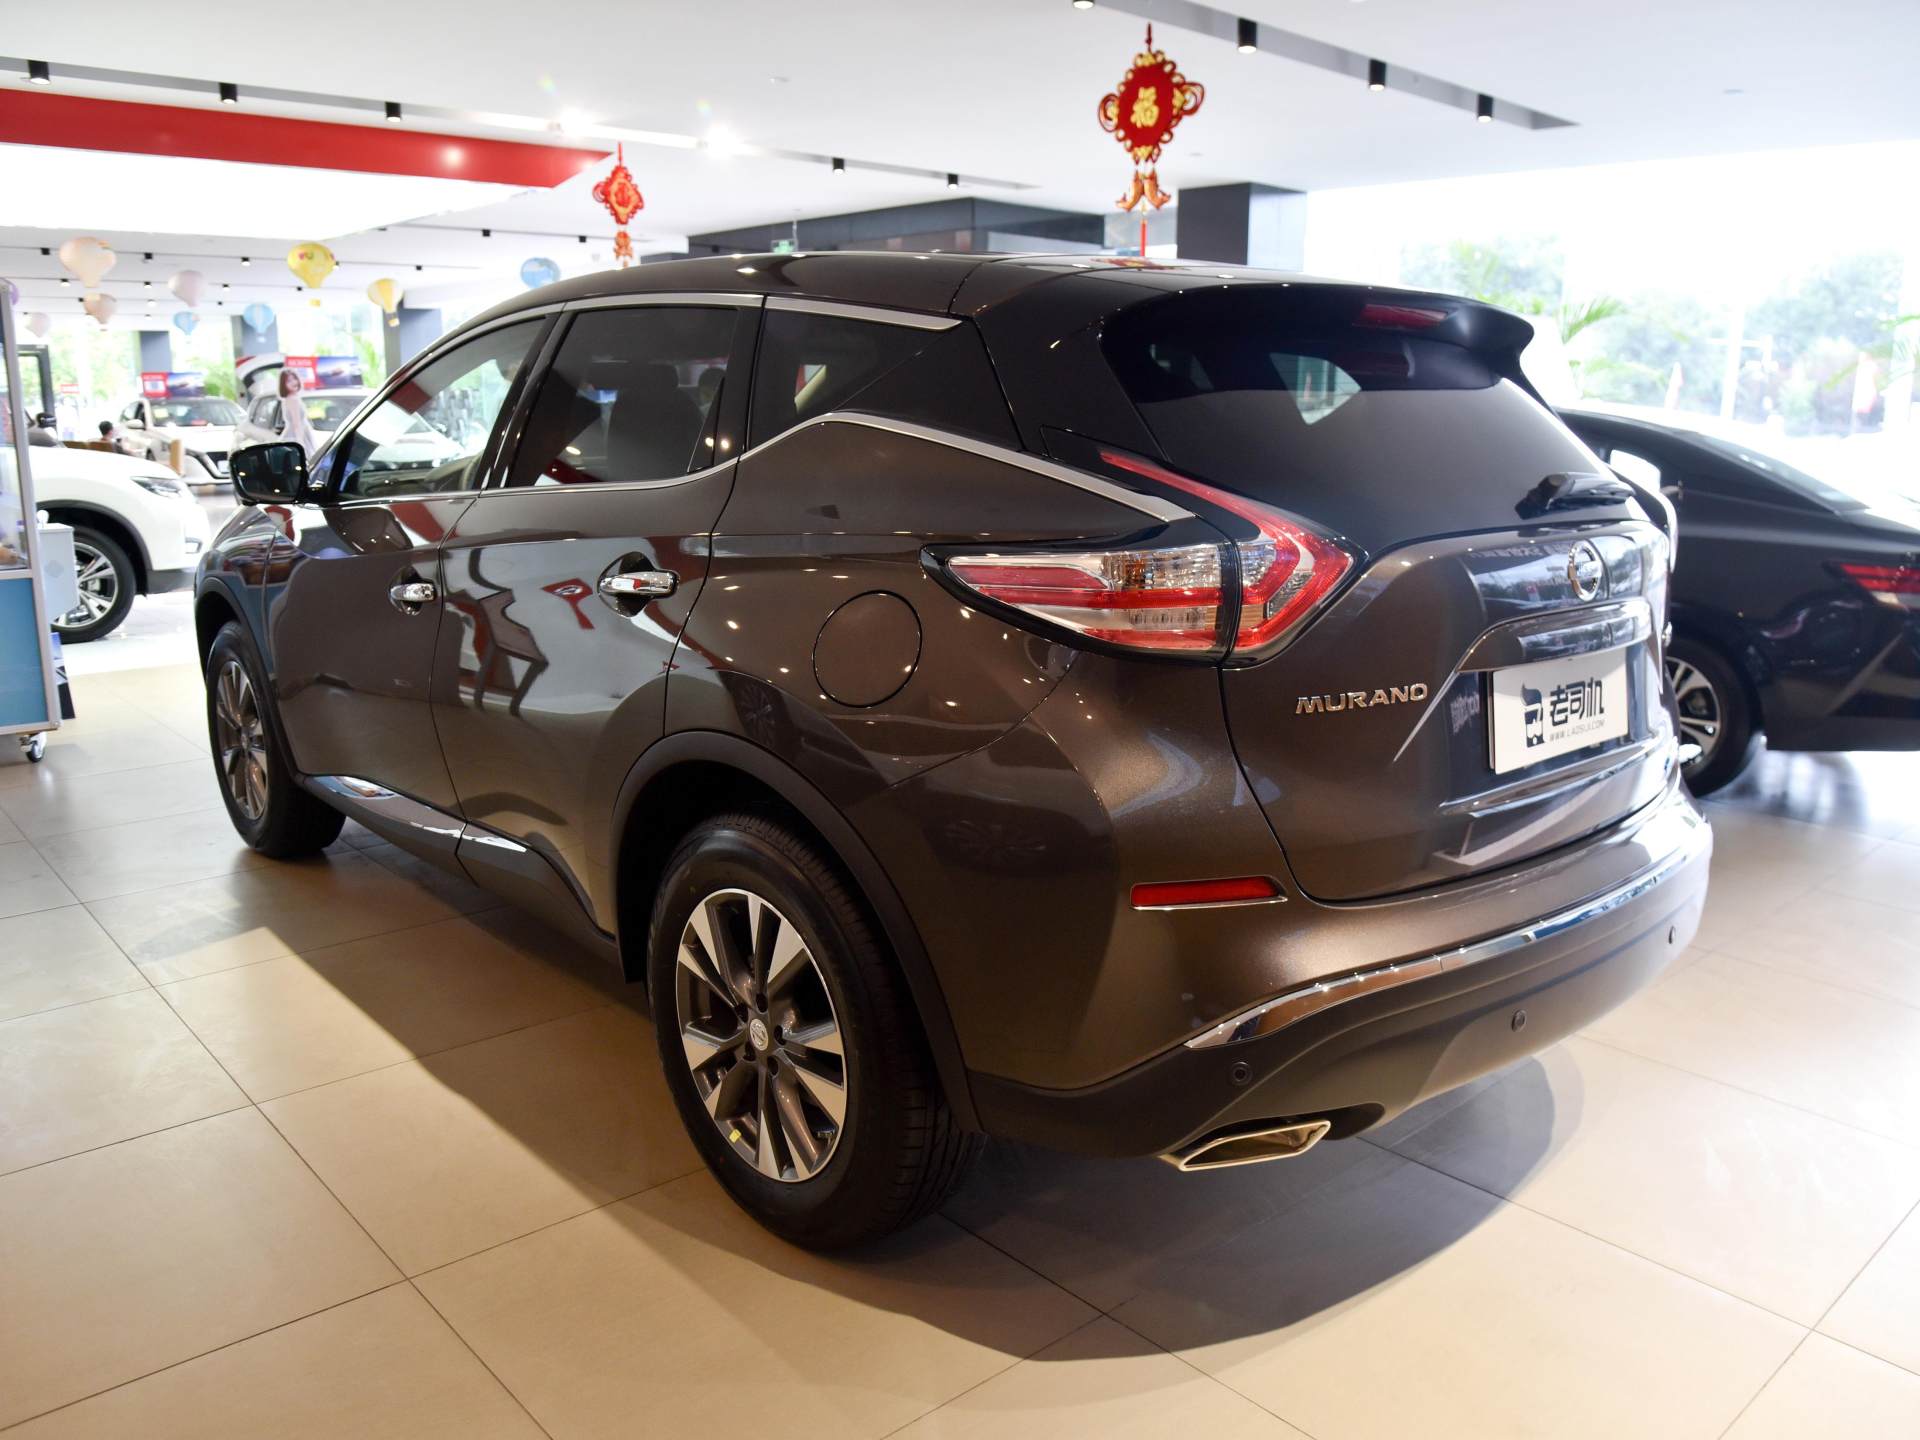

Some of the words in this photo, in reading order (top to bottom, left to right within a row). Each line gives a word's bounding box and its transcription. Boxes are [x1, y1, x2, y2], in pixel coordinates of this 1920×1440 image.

[1295, 683, 1428, 714] MURANO
[1549, 676, 1605, 727] 老司机
